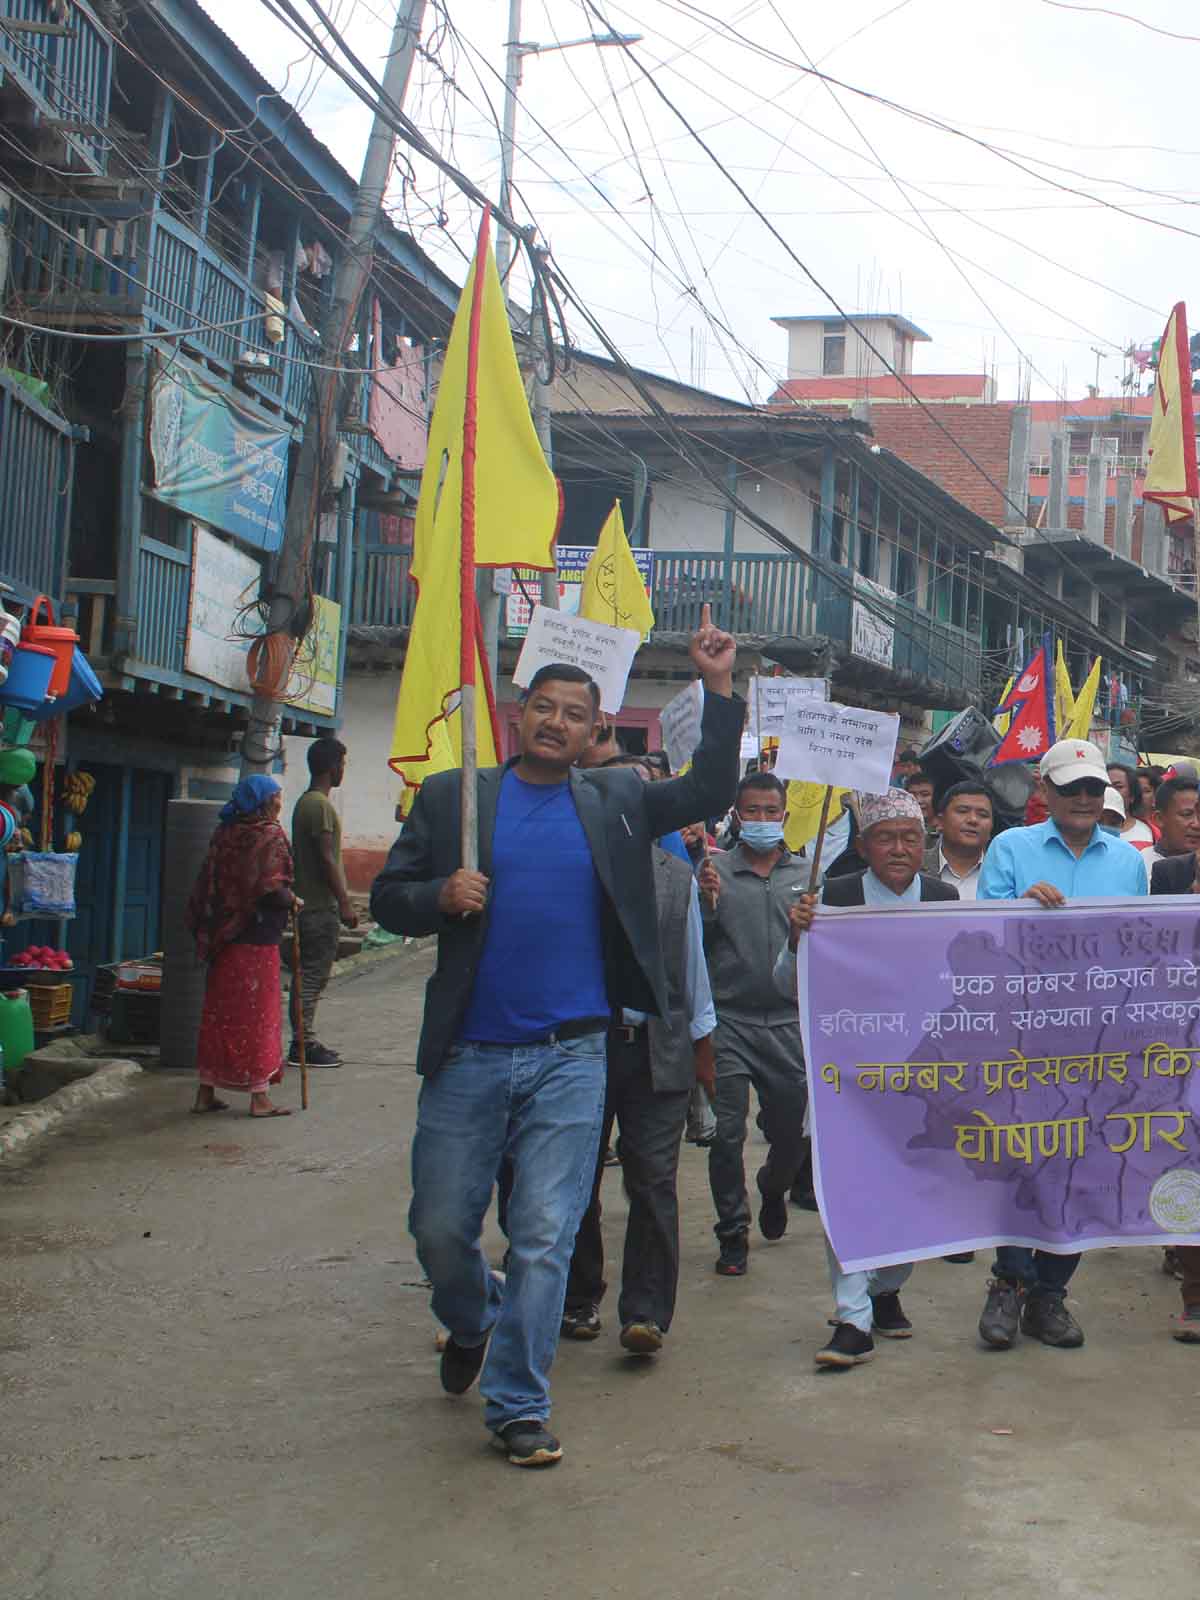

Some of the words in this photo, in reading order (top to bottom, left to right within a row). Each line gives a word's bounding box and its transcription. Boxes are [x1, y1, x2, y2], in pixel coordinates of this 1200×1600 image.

[1004, 972, 1079, 996] नम्बर
[1086, 966, 1159, 992] किरात
[818, 1009, 910, 1037] इतिहास,
[1009, 1007, 1093, 1031] सभ्यता
[1101, 1006, 1119, 1026] त
[820, 1062, 840, 1094] १
[856, 1062, 968, 1093] नम्बर
[981, 1048, 1131, 1095] प्रदेसलाइ
[953, 1109, 1090, 1164] घोषणा
